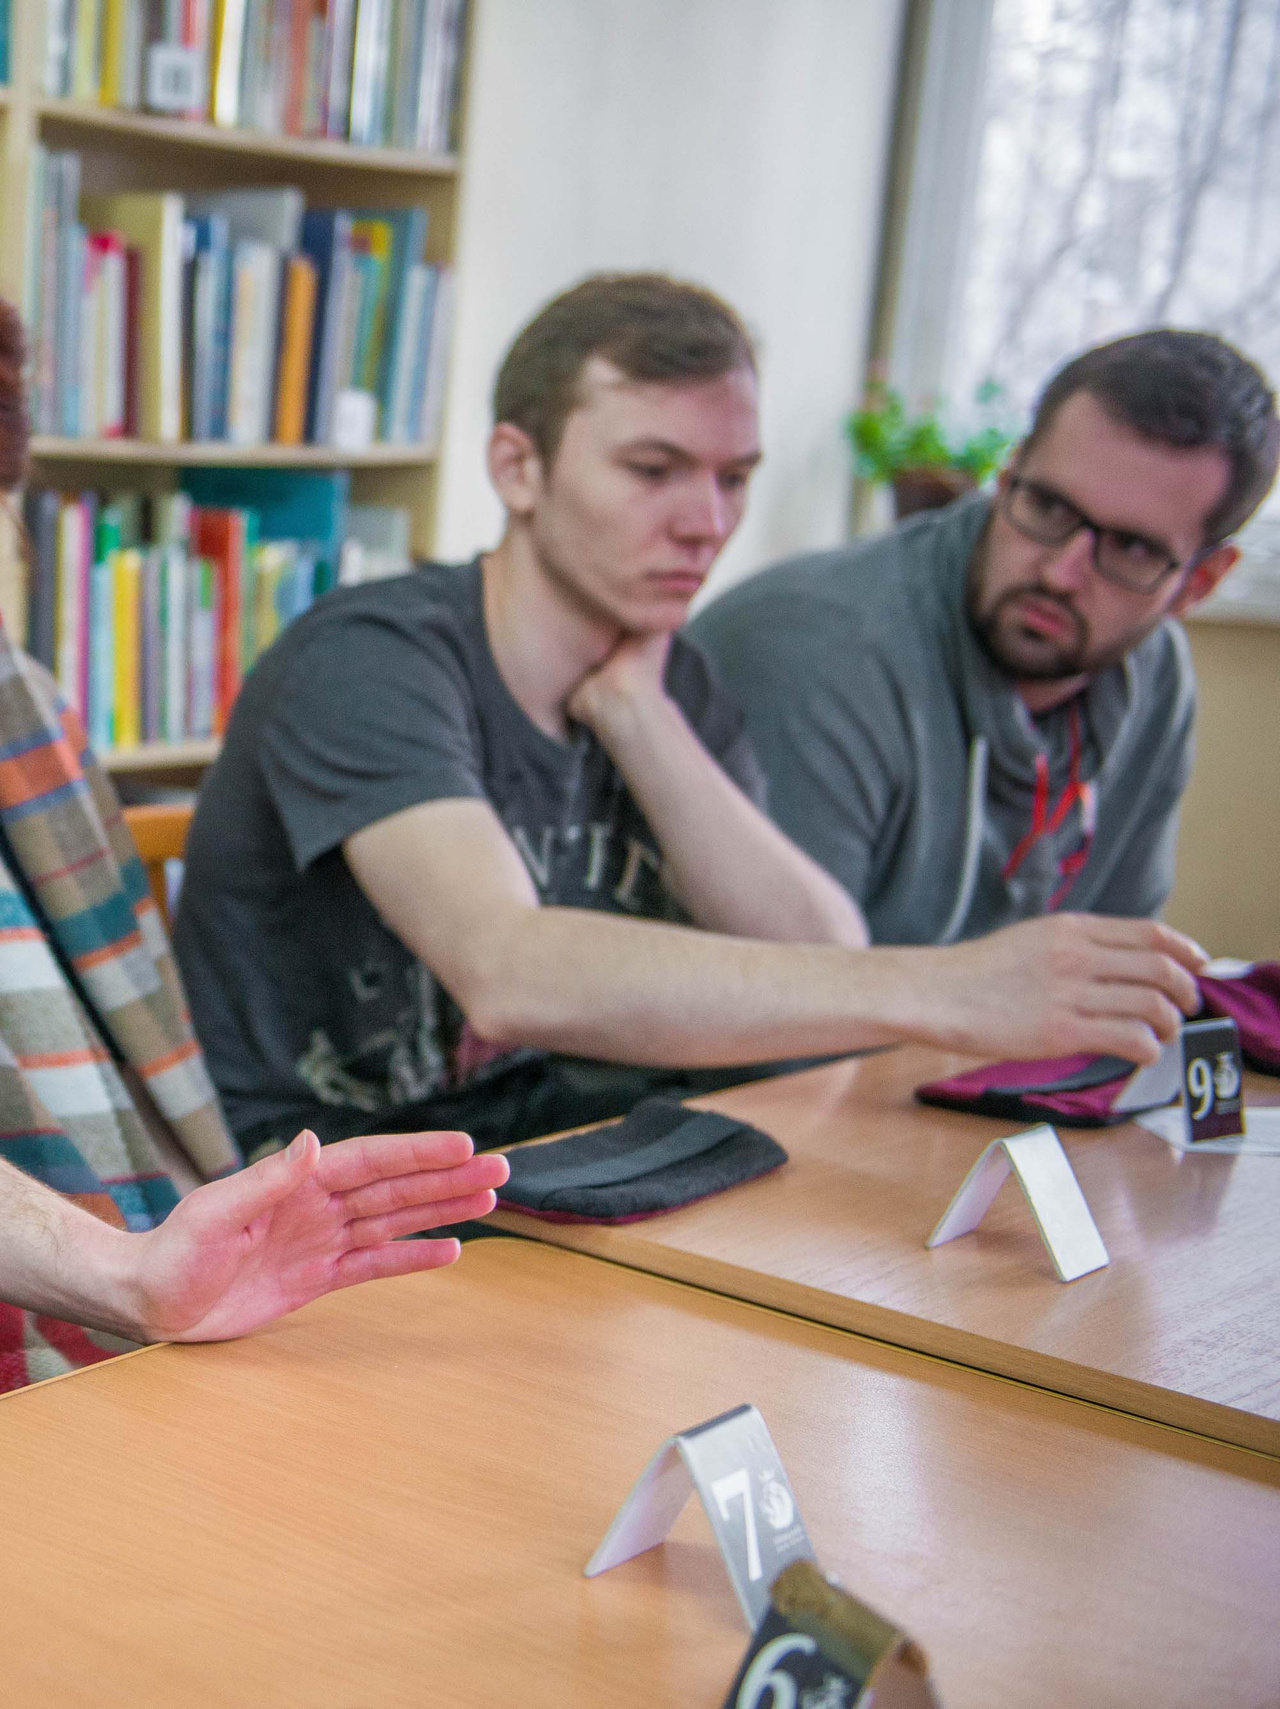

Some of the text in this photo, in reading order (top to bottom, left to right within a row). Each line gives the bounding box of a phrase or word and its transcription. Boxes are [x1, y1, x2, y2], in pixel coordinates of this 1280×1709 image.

[1187, 1056, 1214, 1120] 9
[711, 1466, 763, 1582] 7
[736, 1632, 816, 1709] 6
